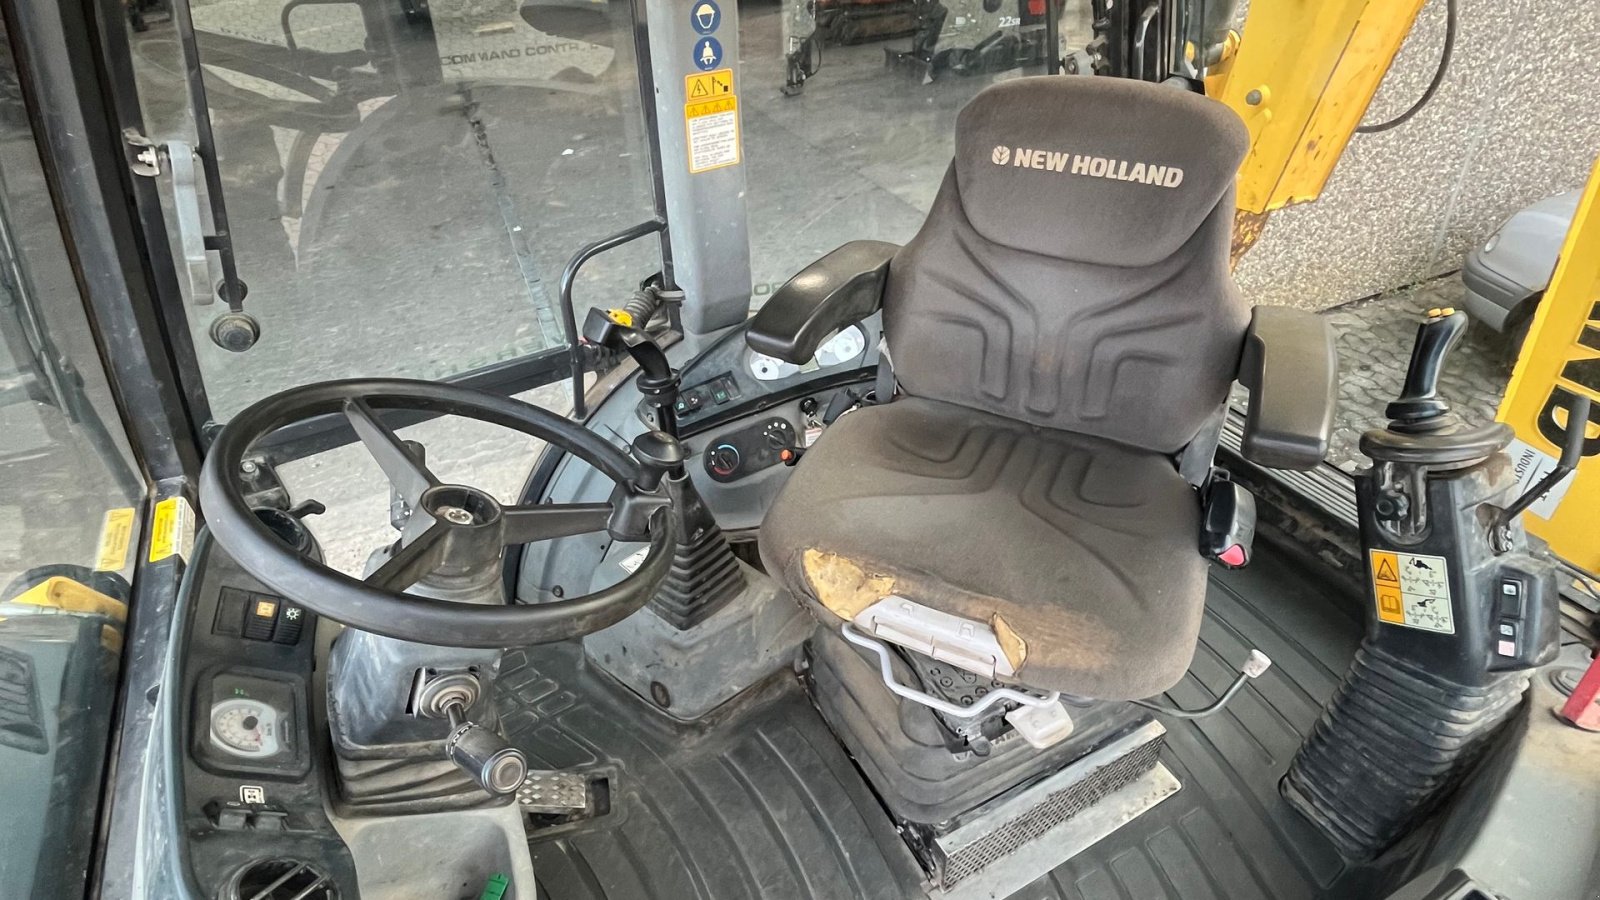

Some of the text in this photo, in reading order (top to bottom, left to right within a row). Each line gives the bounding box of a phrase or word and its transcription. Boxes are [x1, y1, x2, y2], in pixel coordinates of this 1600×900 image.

[1014, 147, 1184, 189] NEW HOLLAND
[1513, 449, 1536, 486] INDUST
